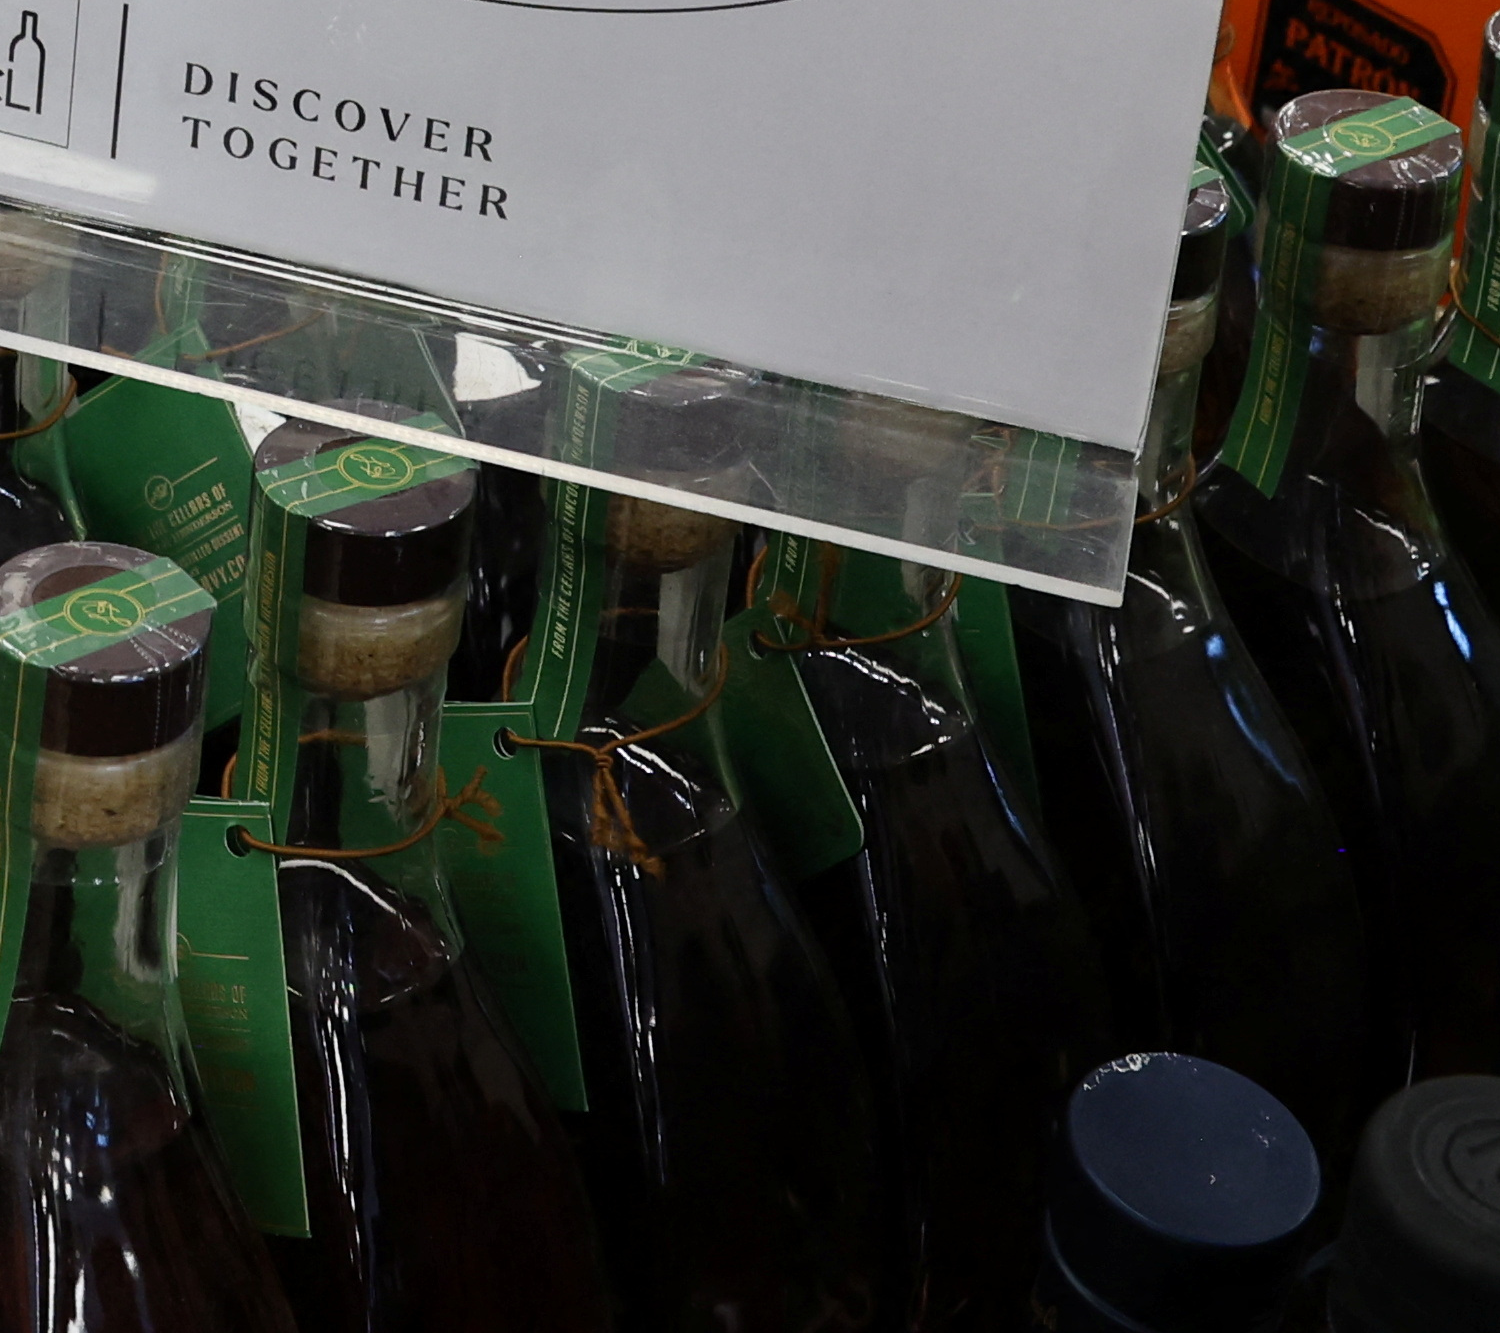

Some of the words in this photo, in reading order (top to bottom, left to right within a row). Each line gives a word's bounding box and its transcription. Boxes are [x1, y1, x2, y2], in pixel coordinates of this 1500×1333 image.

[183, 61, 495, 162] DISCOVER
[181, 115, 509, 220] TOGETHER
[211, 482, 227, 502] OF
[561, 482, 580, 526] LINCO
[561, 526, 576, 544] OF
[257, 549, 279, 622] HENDERSON
[555, 545, 579, 598] CELLARS
[555, 597, 572, 621] THE
[550, 621, 569, 660] FROM
[257, 735, 272, 761] THE
[254, 759, 271, 796] FROM
